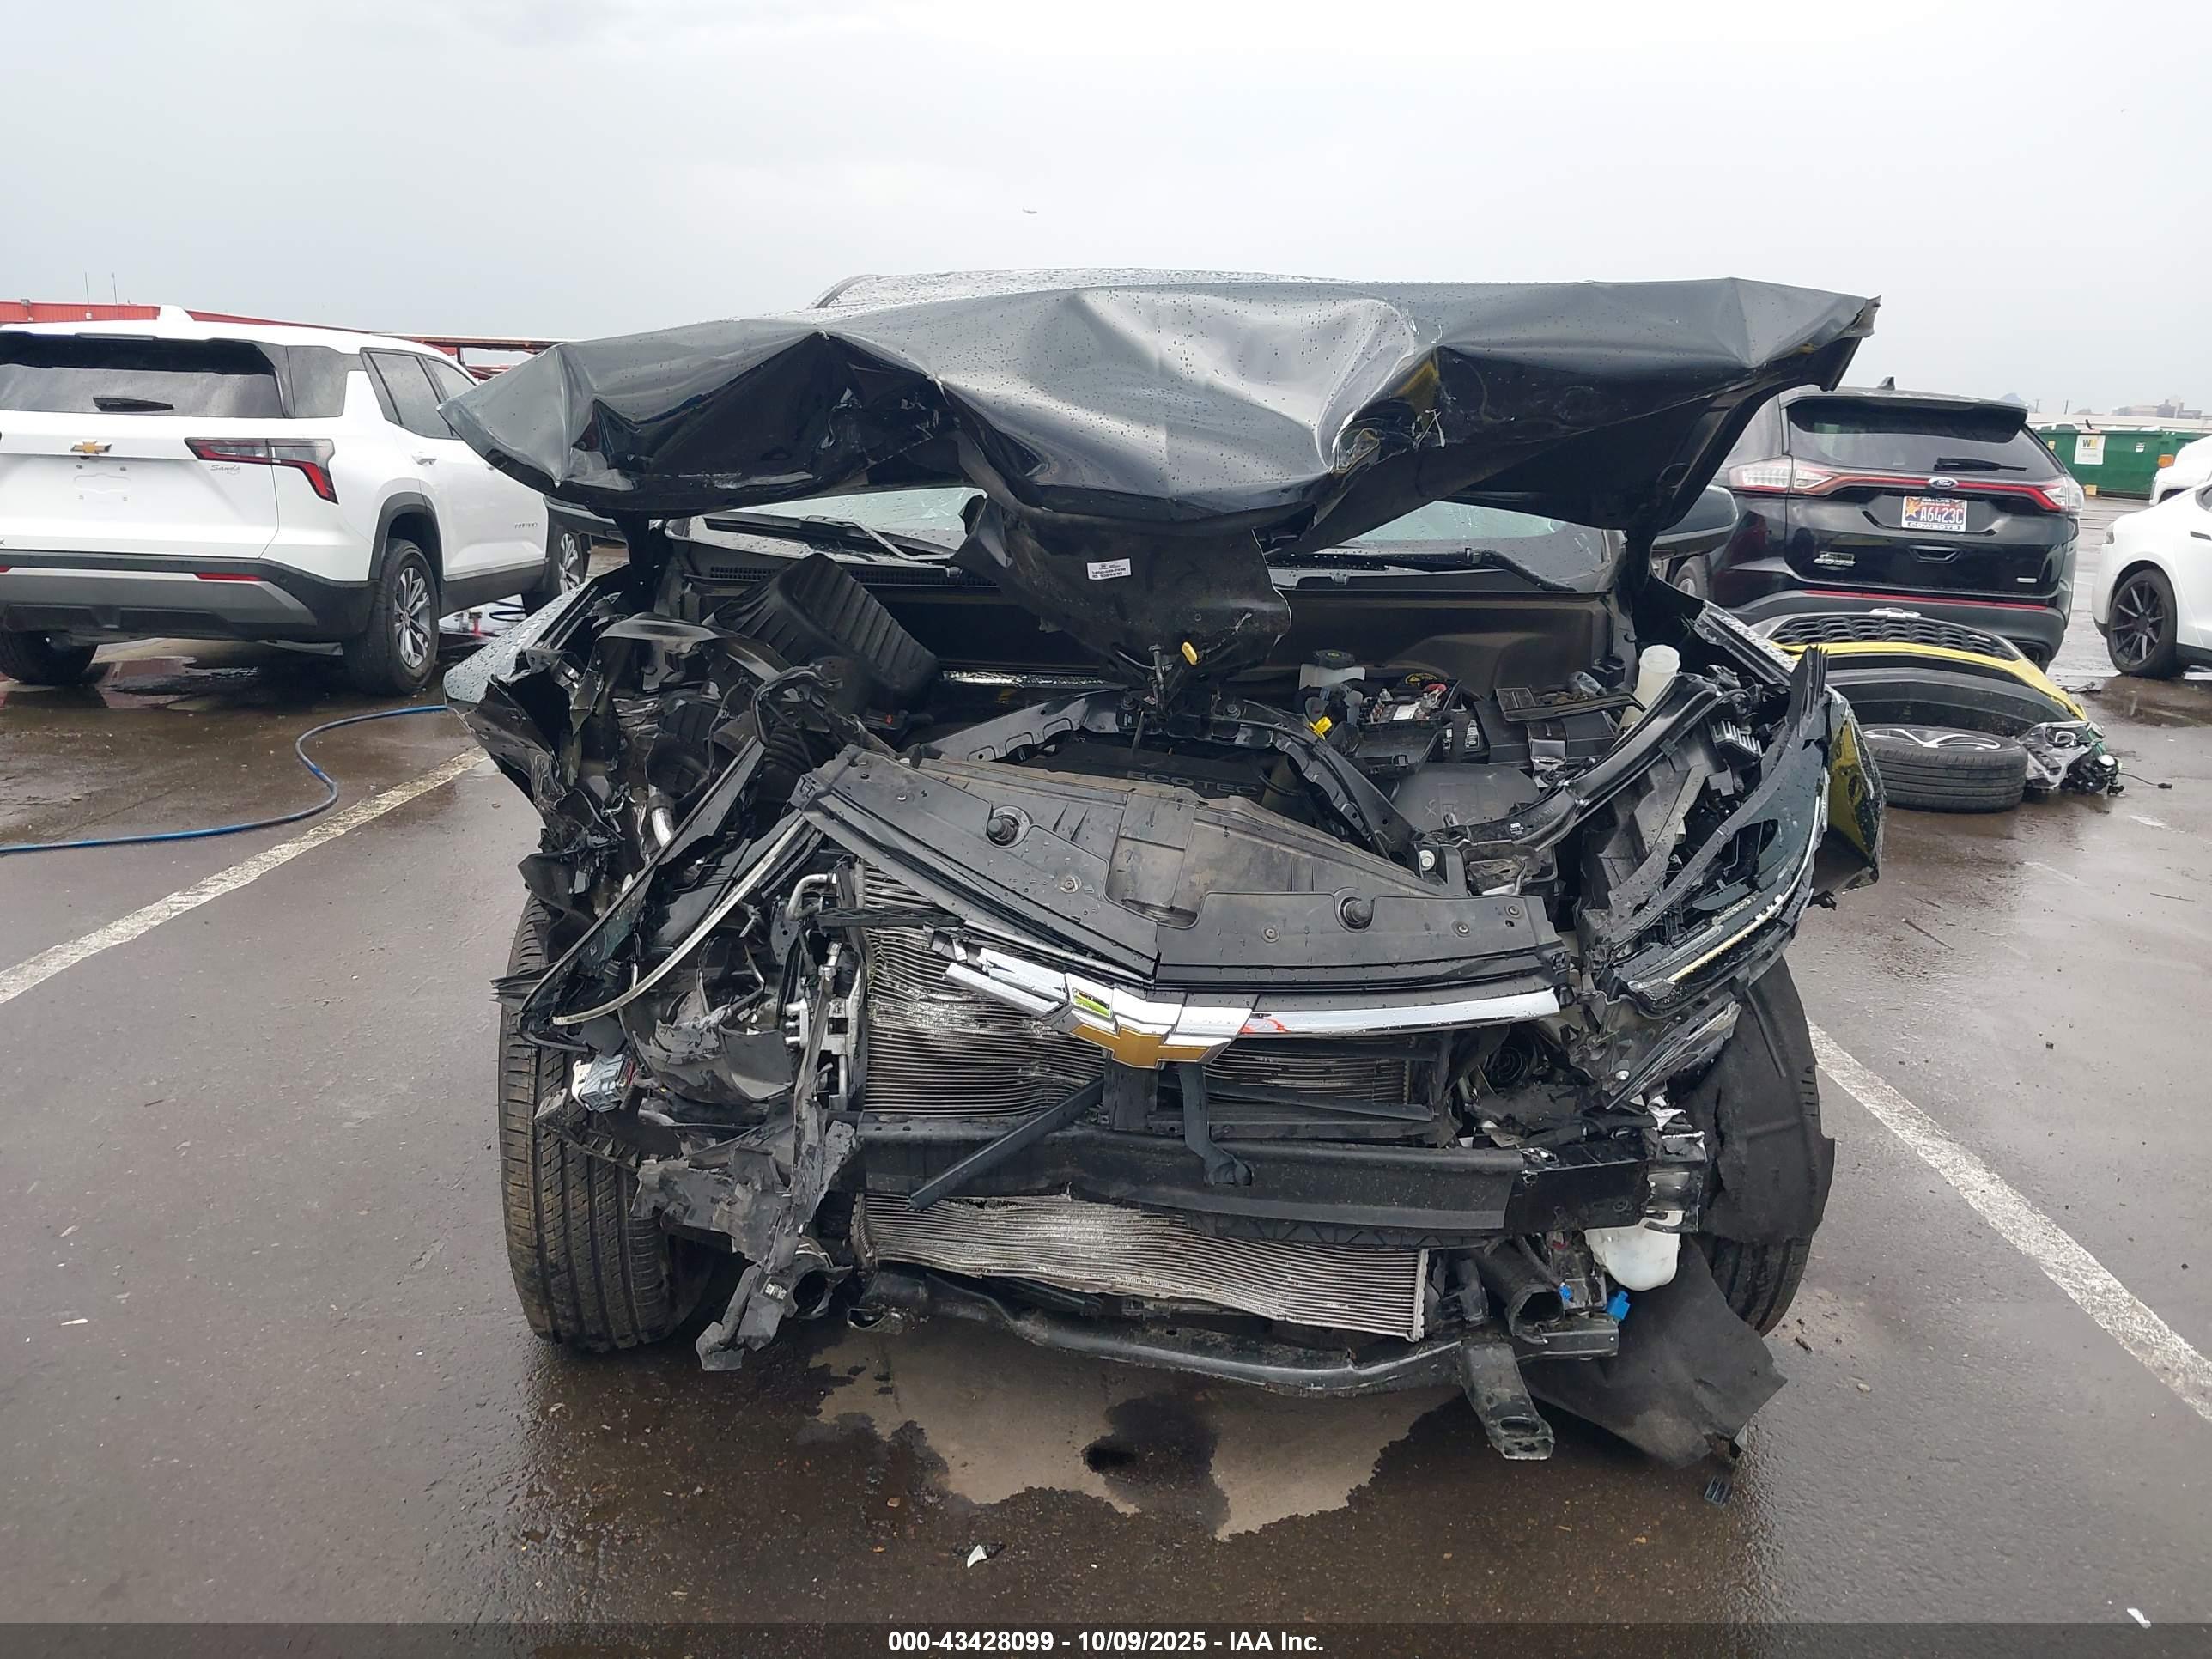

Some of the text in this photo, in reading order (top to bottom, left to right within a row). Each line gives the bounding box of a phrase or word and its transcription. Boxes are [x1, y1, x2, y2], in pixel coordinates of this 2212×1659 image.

[1919, 507, 1964, 524] A6423C
[1909, 522, 1960, 531] COWBOYS
[1127, 771, 1258, 795] ECOTEC
